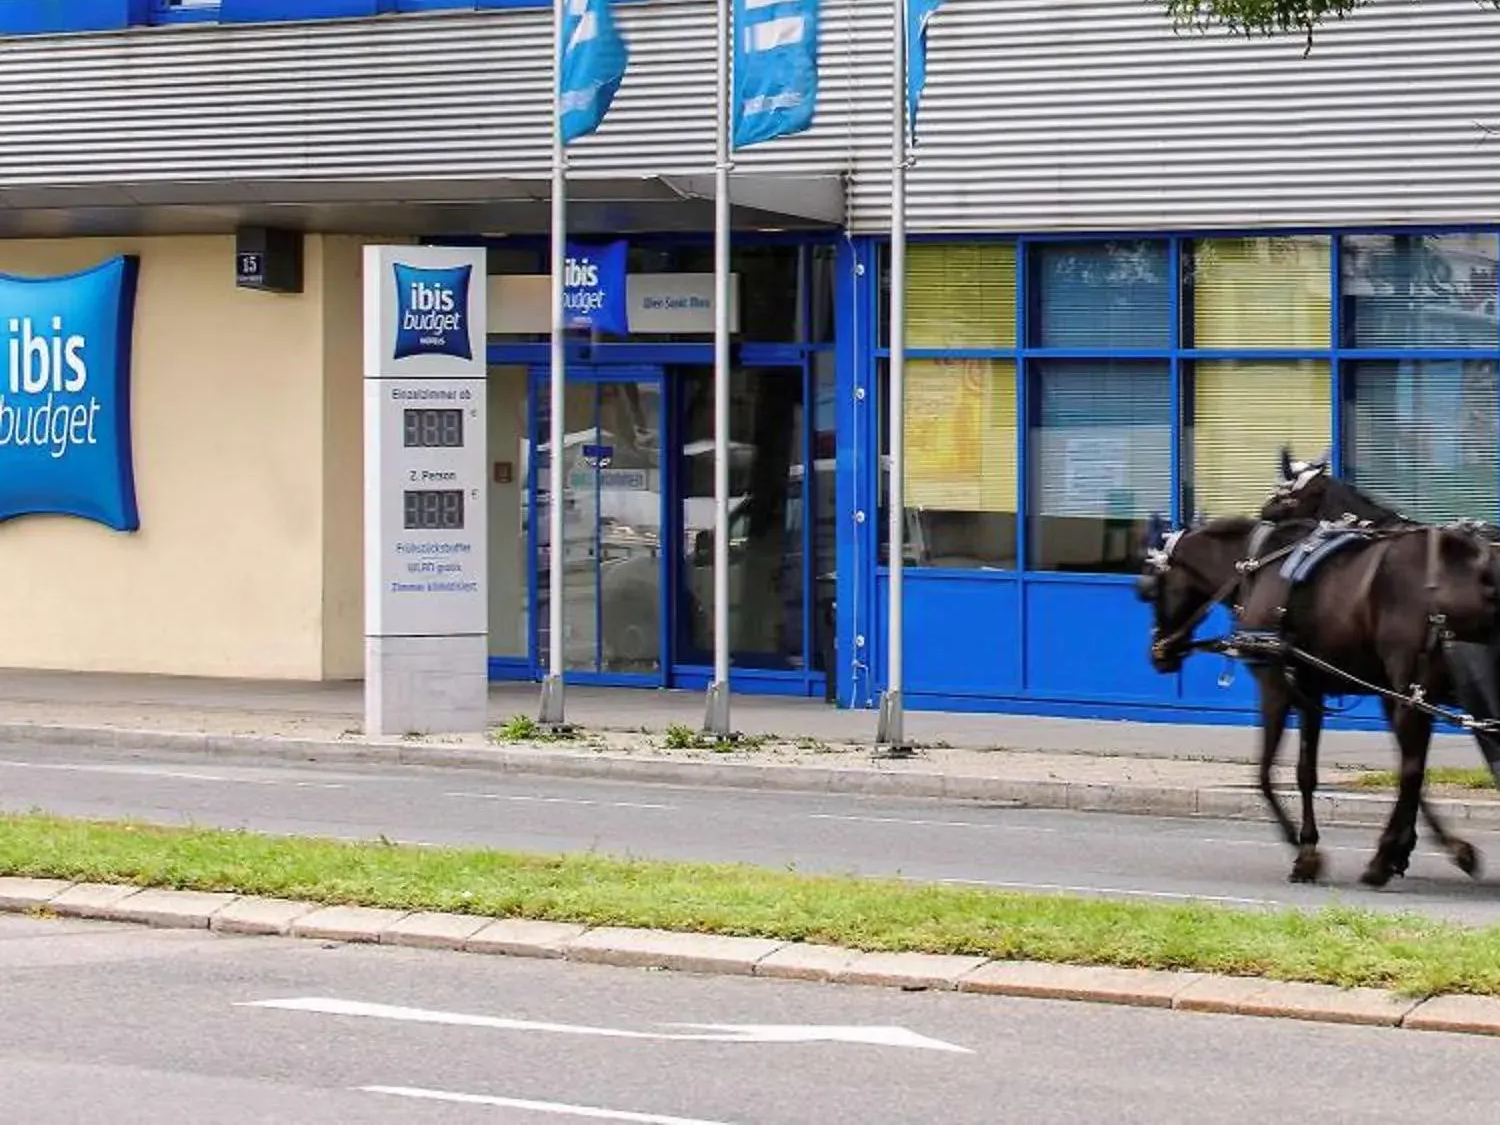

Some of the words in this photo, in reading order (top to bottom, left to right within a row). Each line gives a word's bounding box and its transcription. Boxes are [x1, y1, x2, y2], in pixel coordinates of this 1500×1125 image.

[242, 255, 257, 273] 15
[565, 258, 599, 287] ibis
[411, 281, 455, 312] ibis
[403, 309, 461, 336] budget
[9, 315, 87, 394] ibis
[0, 393, 101, 459] budget
